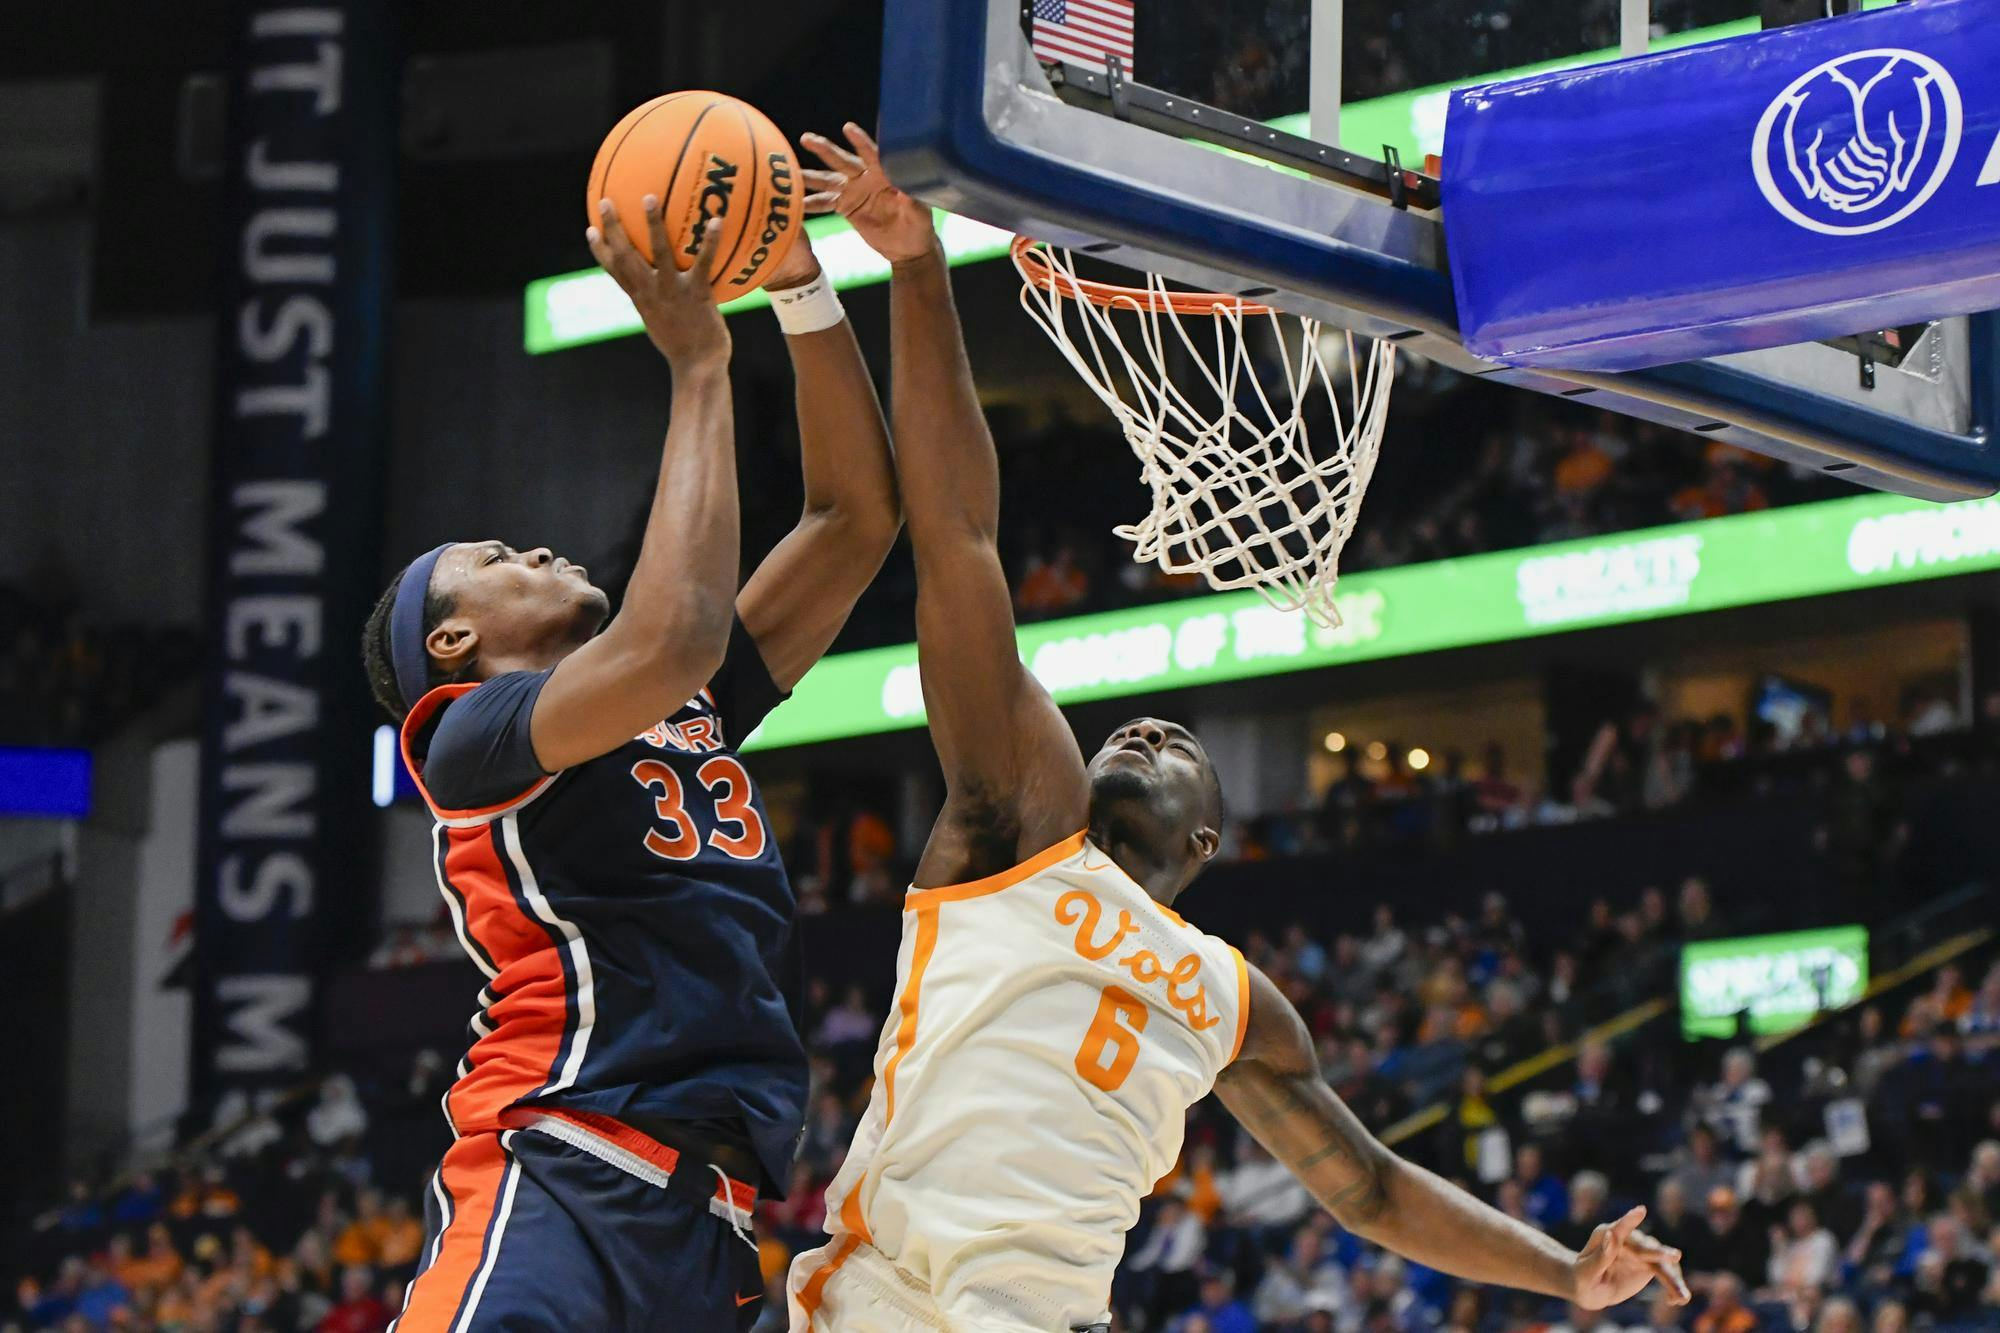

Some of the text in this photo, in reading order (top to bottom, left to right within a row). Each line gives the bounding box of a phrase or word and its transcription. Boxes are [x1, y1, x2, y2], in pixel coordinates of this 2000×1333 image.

[251, 8, 344, 116] IT
[729, 152, 793, 286] Wilson
[237, 136, 341, 439] JUST
[217, 478, 328, 922] MEANS
[631, 755, 767, 861] 33
[1054, 889, 1221, 1031] Vols
[1074, 985, 1149, 1092] 6
